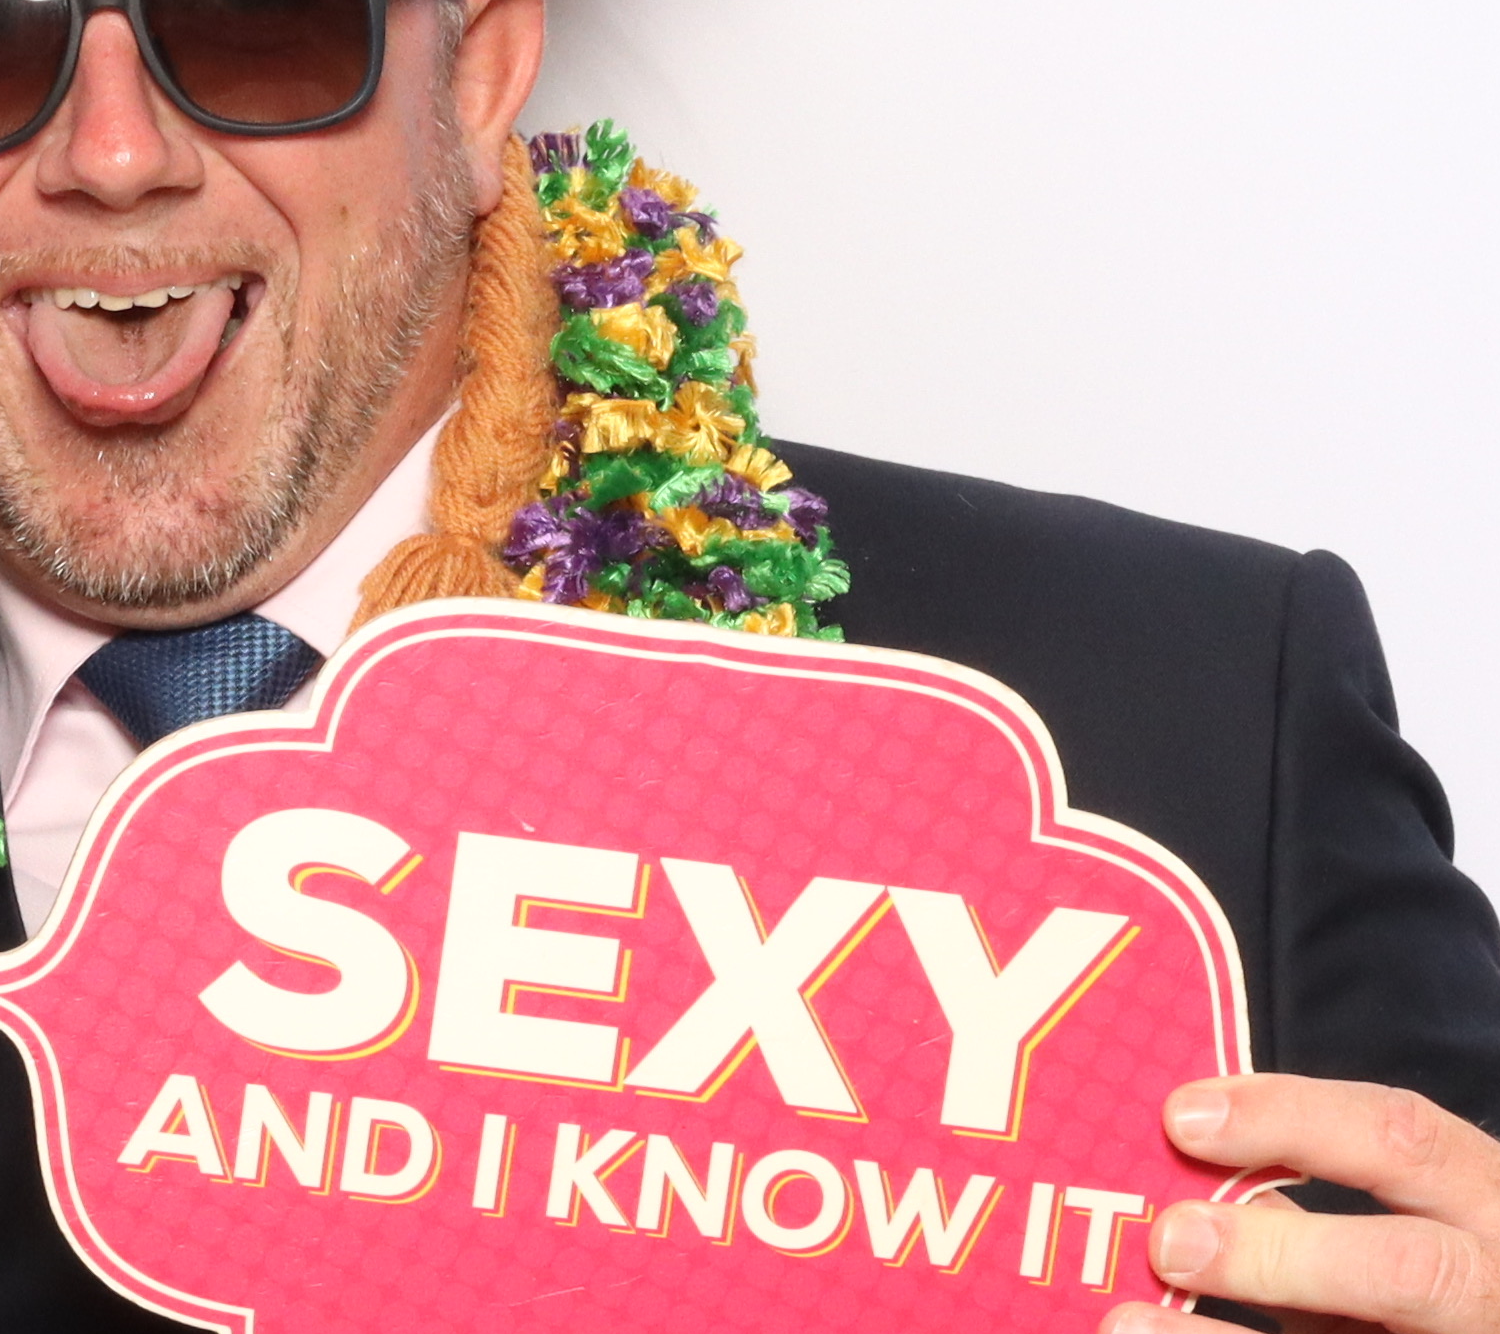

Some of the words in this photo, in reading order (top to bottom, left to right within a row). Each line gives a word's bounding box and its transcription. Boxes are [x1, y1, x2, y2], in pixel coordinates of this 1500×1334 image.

[199, 807, 1140, 1140] SEXY
[117, 1073, 440, 1203] AND
[471, 1114, 515, 1217] I
[545, 1123, 1003, 1273] KNOW
[1018, 1181, 1152, 1294] IT
